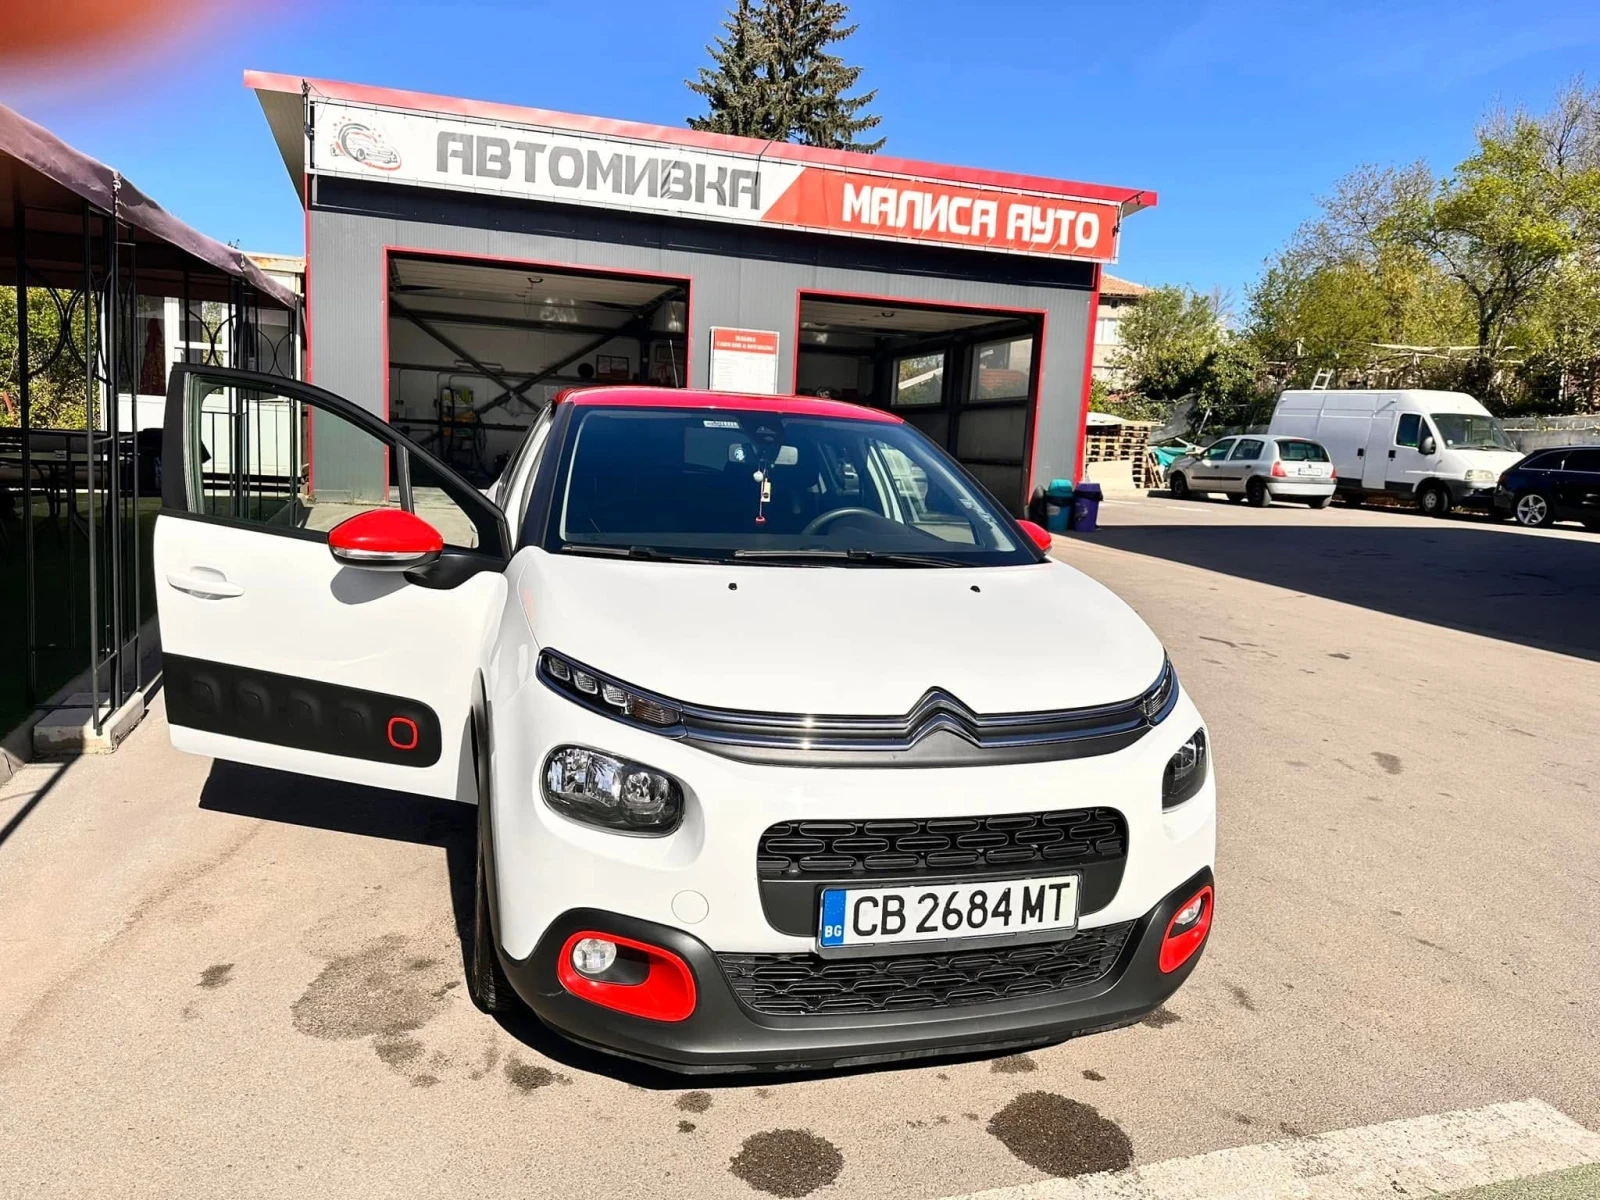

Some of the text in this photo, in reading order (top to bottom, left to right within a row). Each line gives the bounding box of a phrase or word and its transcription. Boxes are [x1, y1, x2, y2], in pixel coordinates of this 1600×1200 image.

[437, 131, 762, 210] АВТОМИВКА
[842, 182, 1100, 249] МАЛИСА АУТО
[824, 925, 843, 938] BG
[852, 882, 1071, 937] CB 2684 MT
